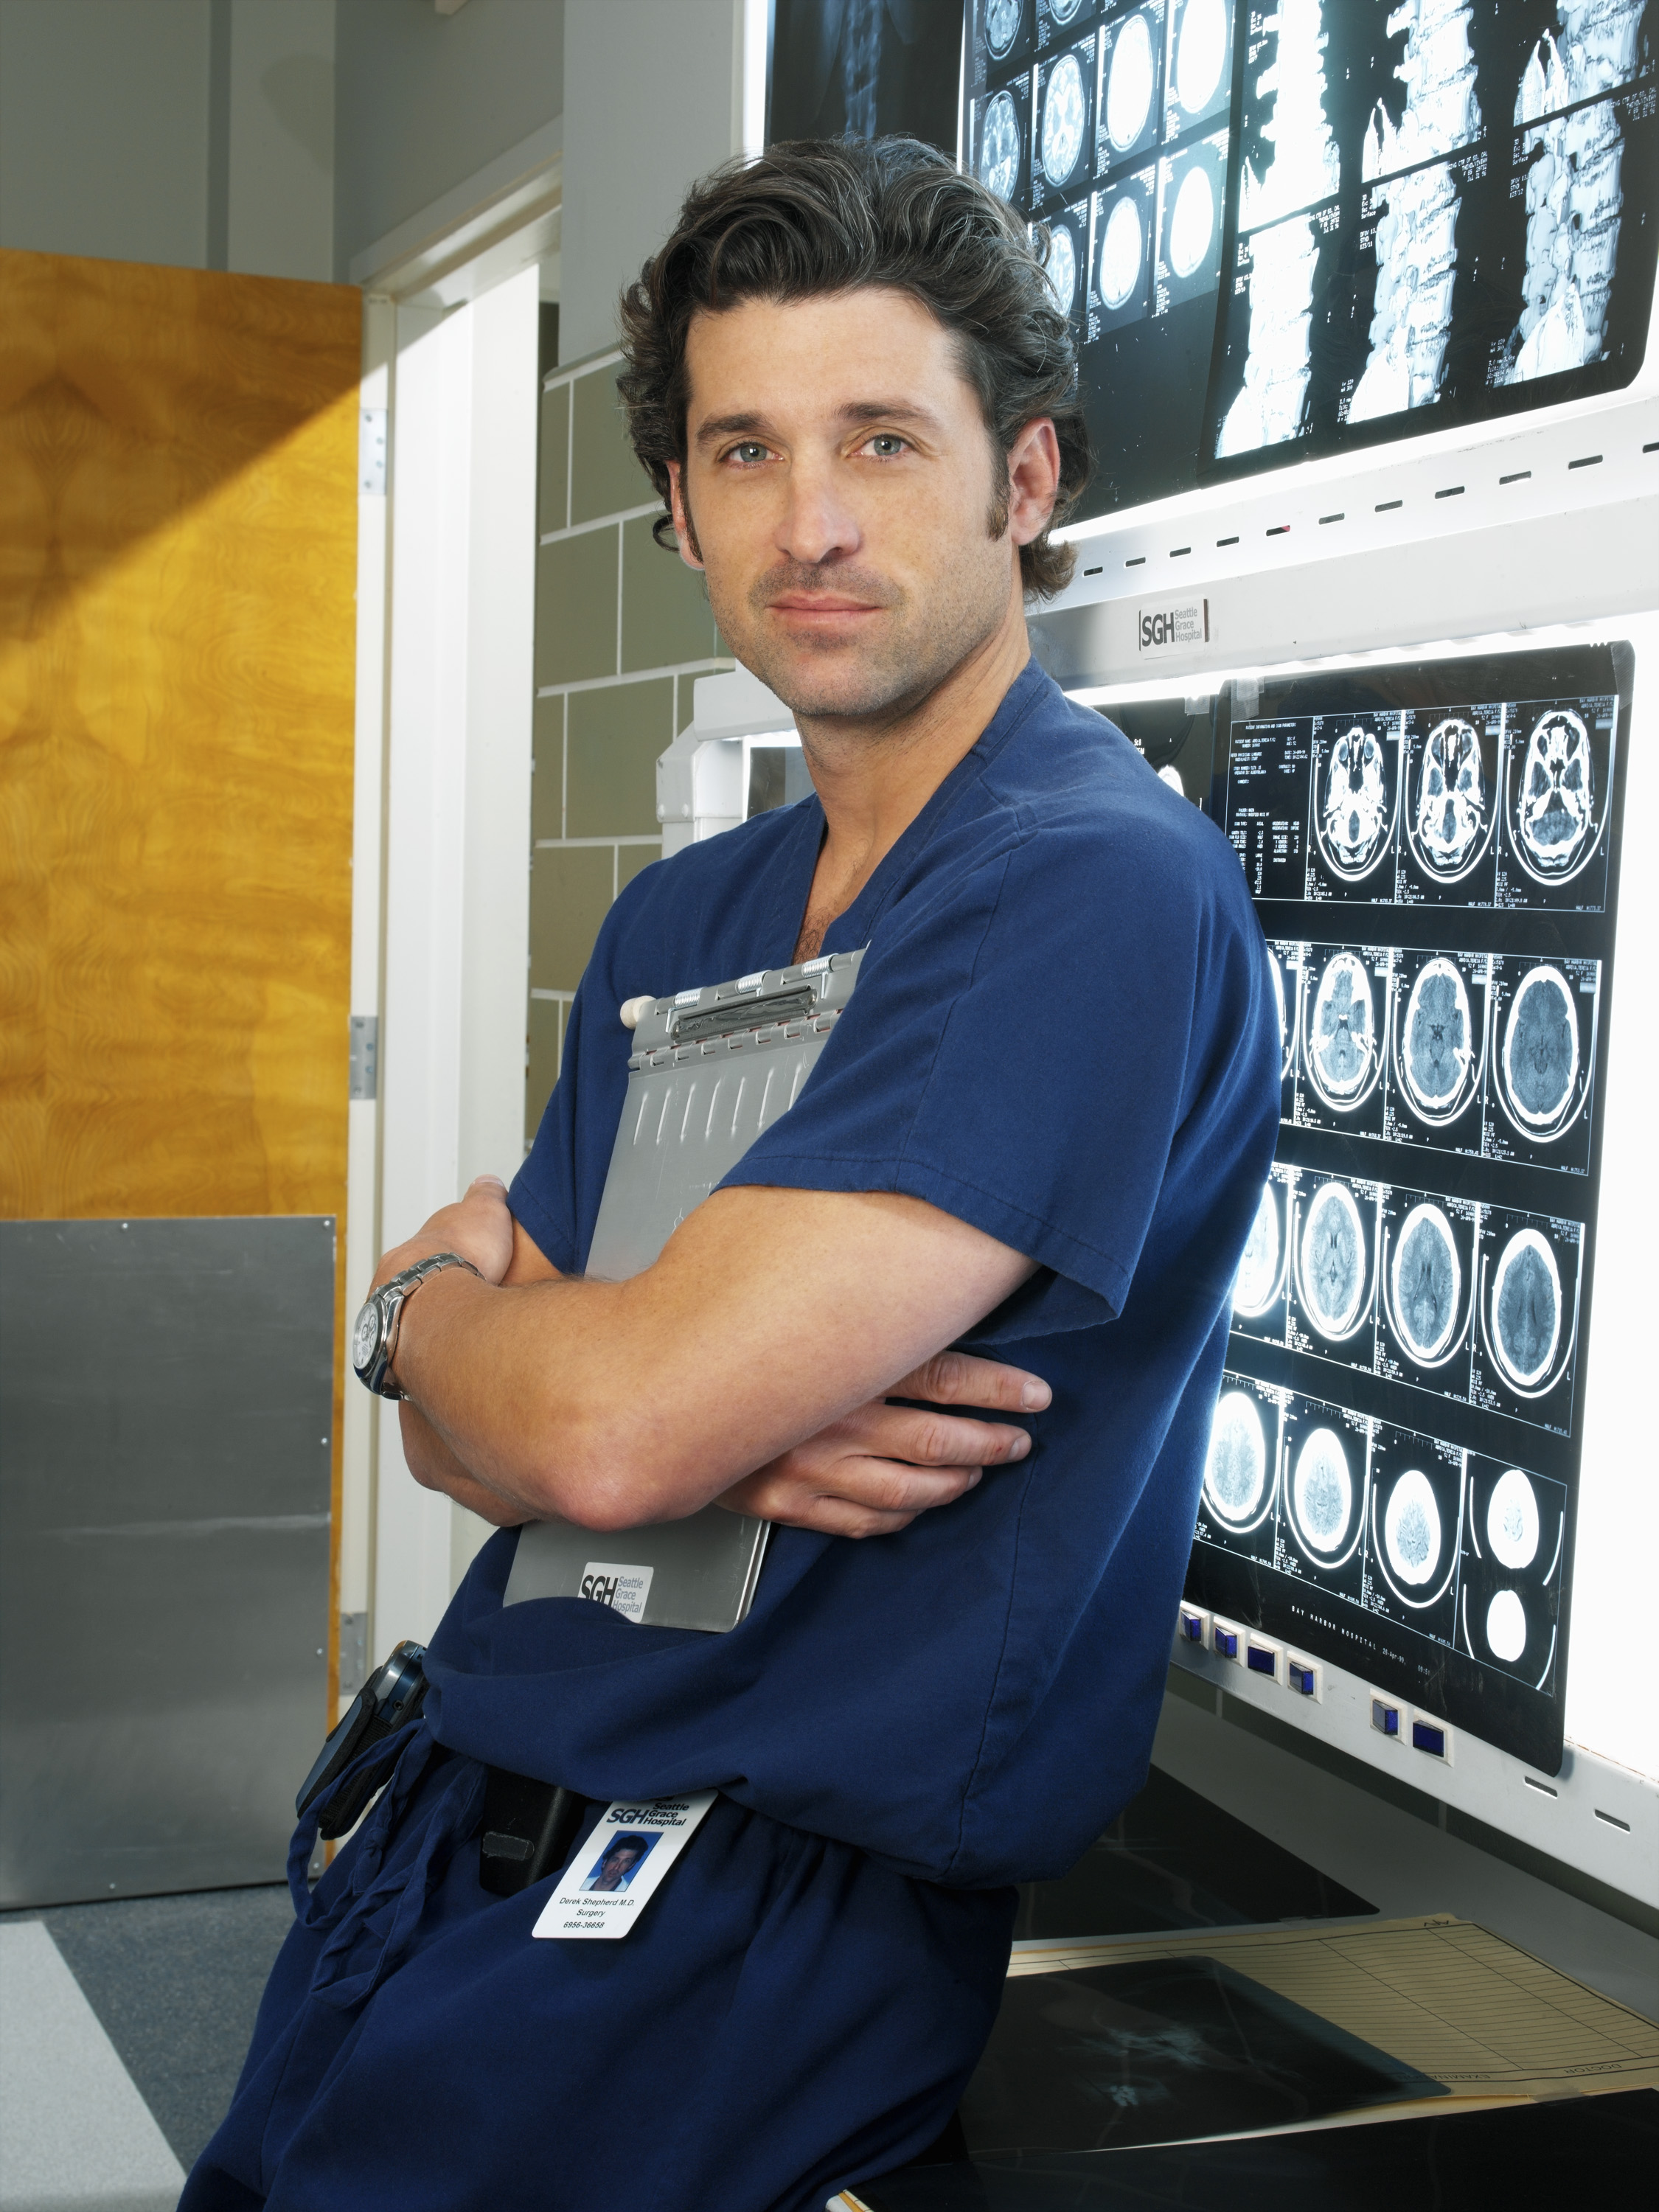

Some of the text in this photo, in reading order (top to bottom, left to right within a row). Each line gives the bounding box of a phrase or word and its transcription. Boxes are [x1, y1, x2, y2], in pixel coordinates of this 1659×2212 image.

[1512, 156, 1528, 165] Surface
[1361, 211, 1376, 220] Surface
[1175, 607, 1197, 619] Seattle
[1142, 612, 1175, 647] SGH
[1175, 620, 1194, 630] Grace
[1175, 628, 1202, 643] Hospital
[618, 1576, 643, 1588] Seattle
[582, 1575, 619, 1606] SGH
[616, 1588, 636, 1600] Grace
[613, 1600, 641, 1614] Hospital
[1292, 1605, 1304, 1616] BAY
[1310, 1614, 1336, 1630] HARBOR
[1341, 1629, 1376, 1650] HOSPITAL
[653, 1803, 689, 1811] Seattle
[606, 1809, 649, 1824] SGH
[643, 1817, 686, 1826] Hospital
[1564, 2063, 1622, 2074] DOCTOR
